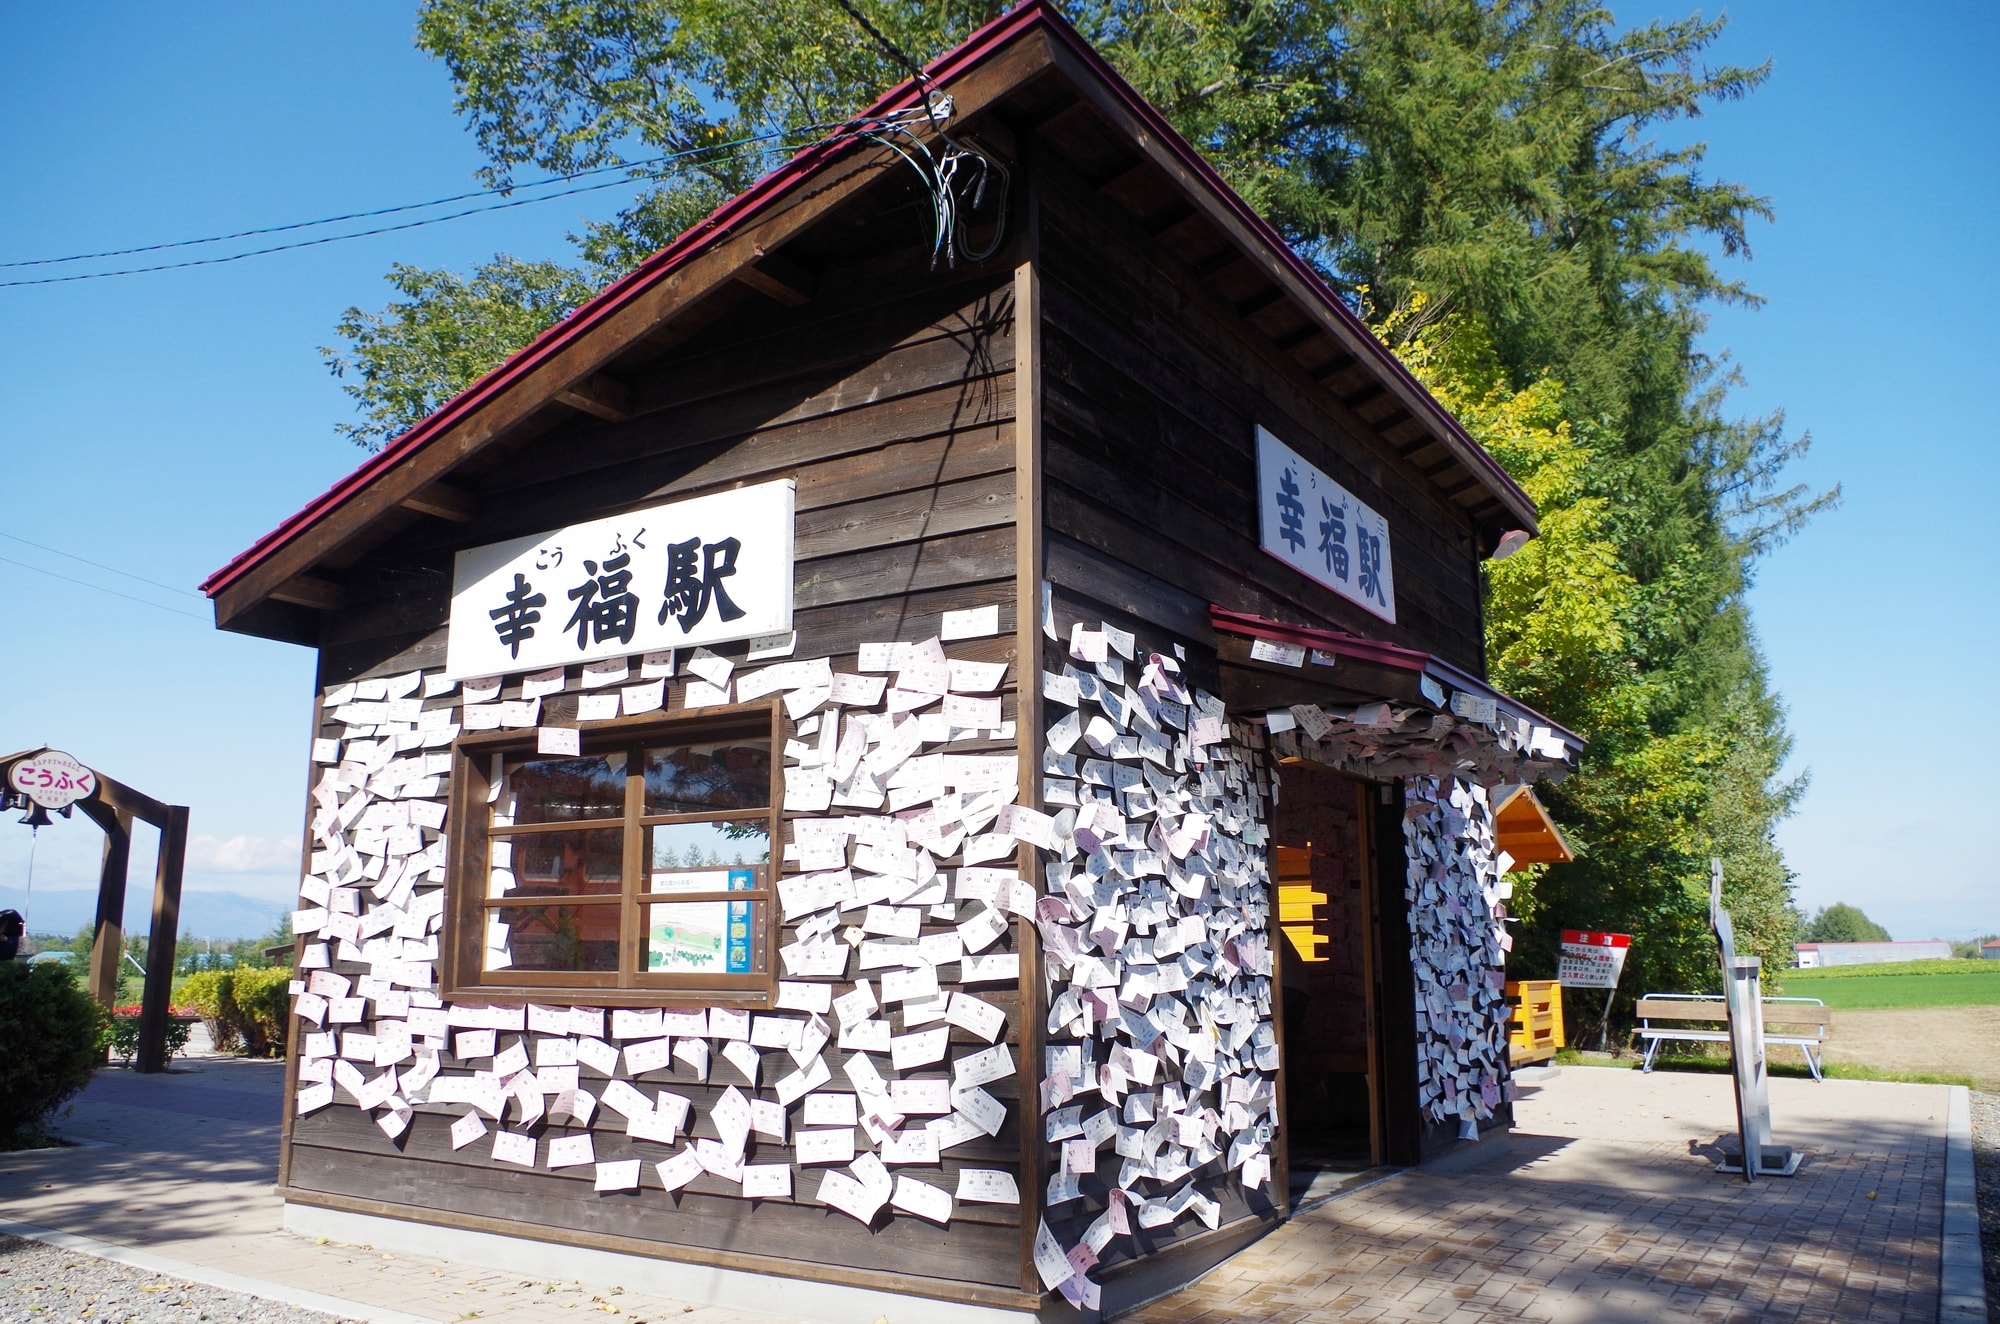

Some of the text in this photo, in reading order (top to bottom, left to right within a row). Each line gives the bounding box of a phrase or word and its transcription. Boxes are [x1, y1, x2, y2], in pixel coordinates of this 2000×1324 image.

[489, 536, 746, 660] 幸福駅
[1276, 467, 1387, 608] 幸福駅
[18, 767, 90, 793] こうふく
